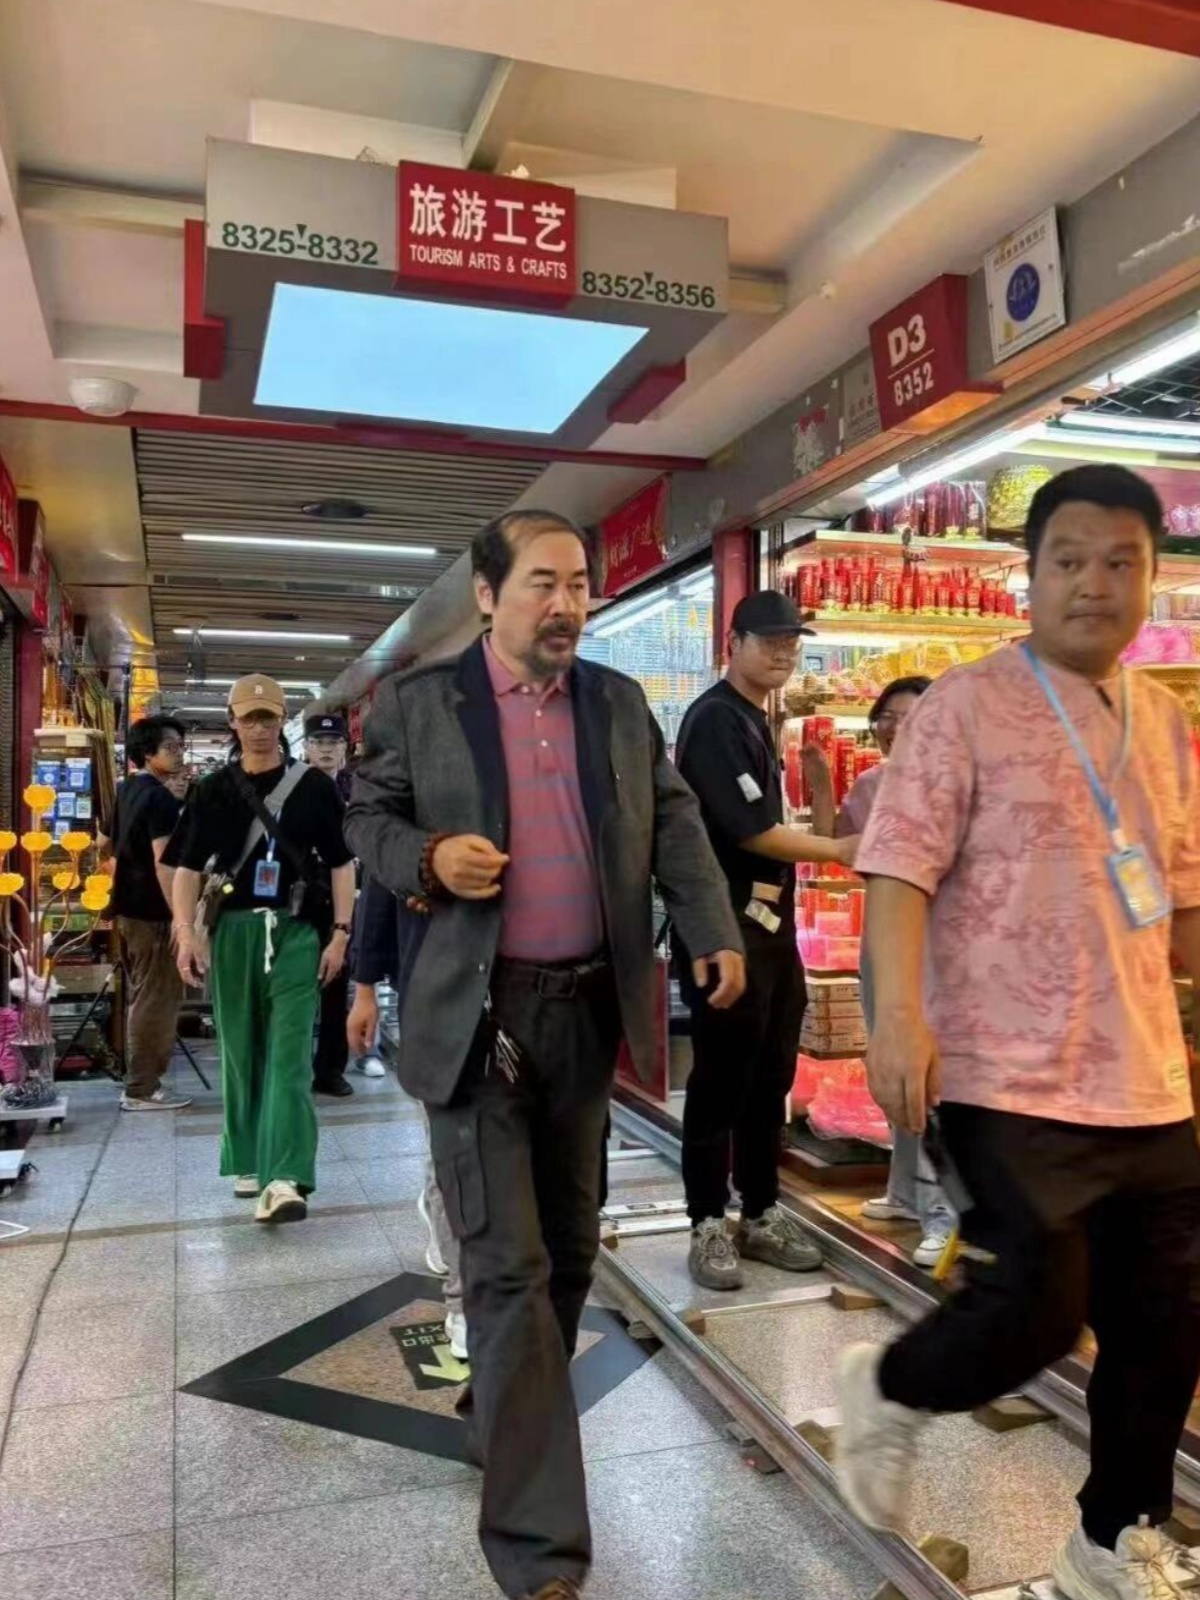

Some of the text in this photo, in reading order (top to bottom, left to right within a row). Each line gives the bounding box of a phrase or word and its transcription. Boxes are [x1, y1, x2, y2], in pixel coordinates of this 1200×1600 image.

[409, 183, 566, 252] 旅游工艺
[222, 222, 378, 265] 8325-8332
[468, 252, 501, 271] ARTS
[506, 256, 515, 273] &
[521, 258, 567, 279] CRAFTS
[582, 271, 715, 308] 8352-8356
[887, 314, 926, 367] D3
[894, 362, 934, 406] 8352
[404, 1325, 443, 1335] XIT
